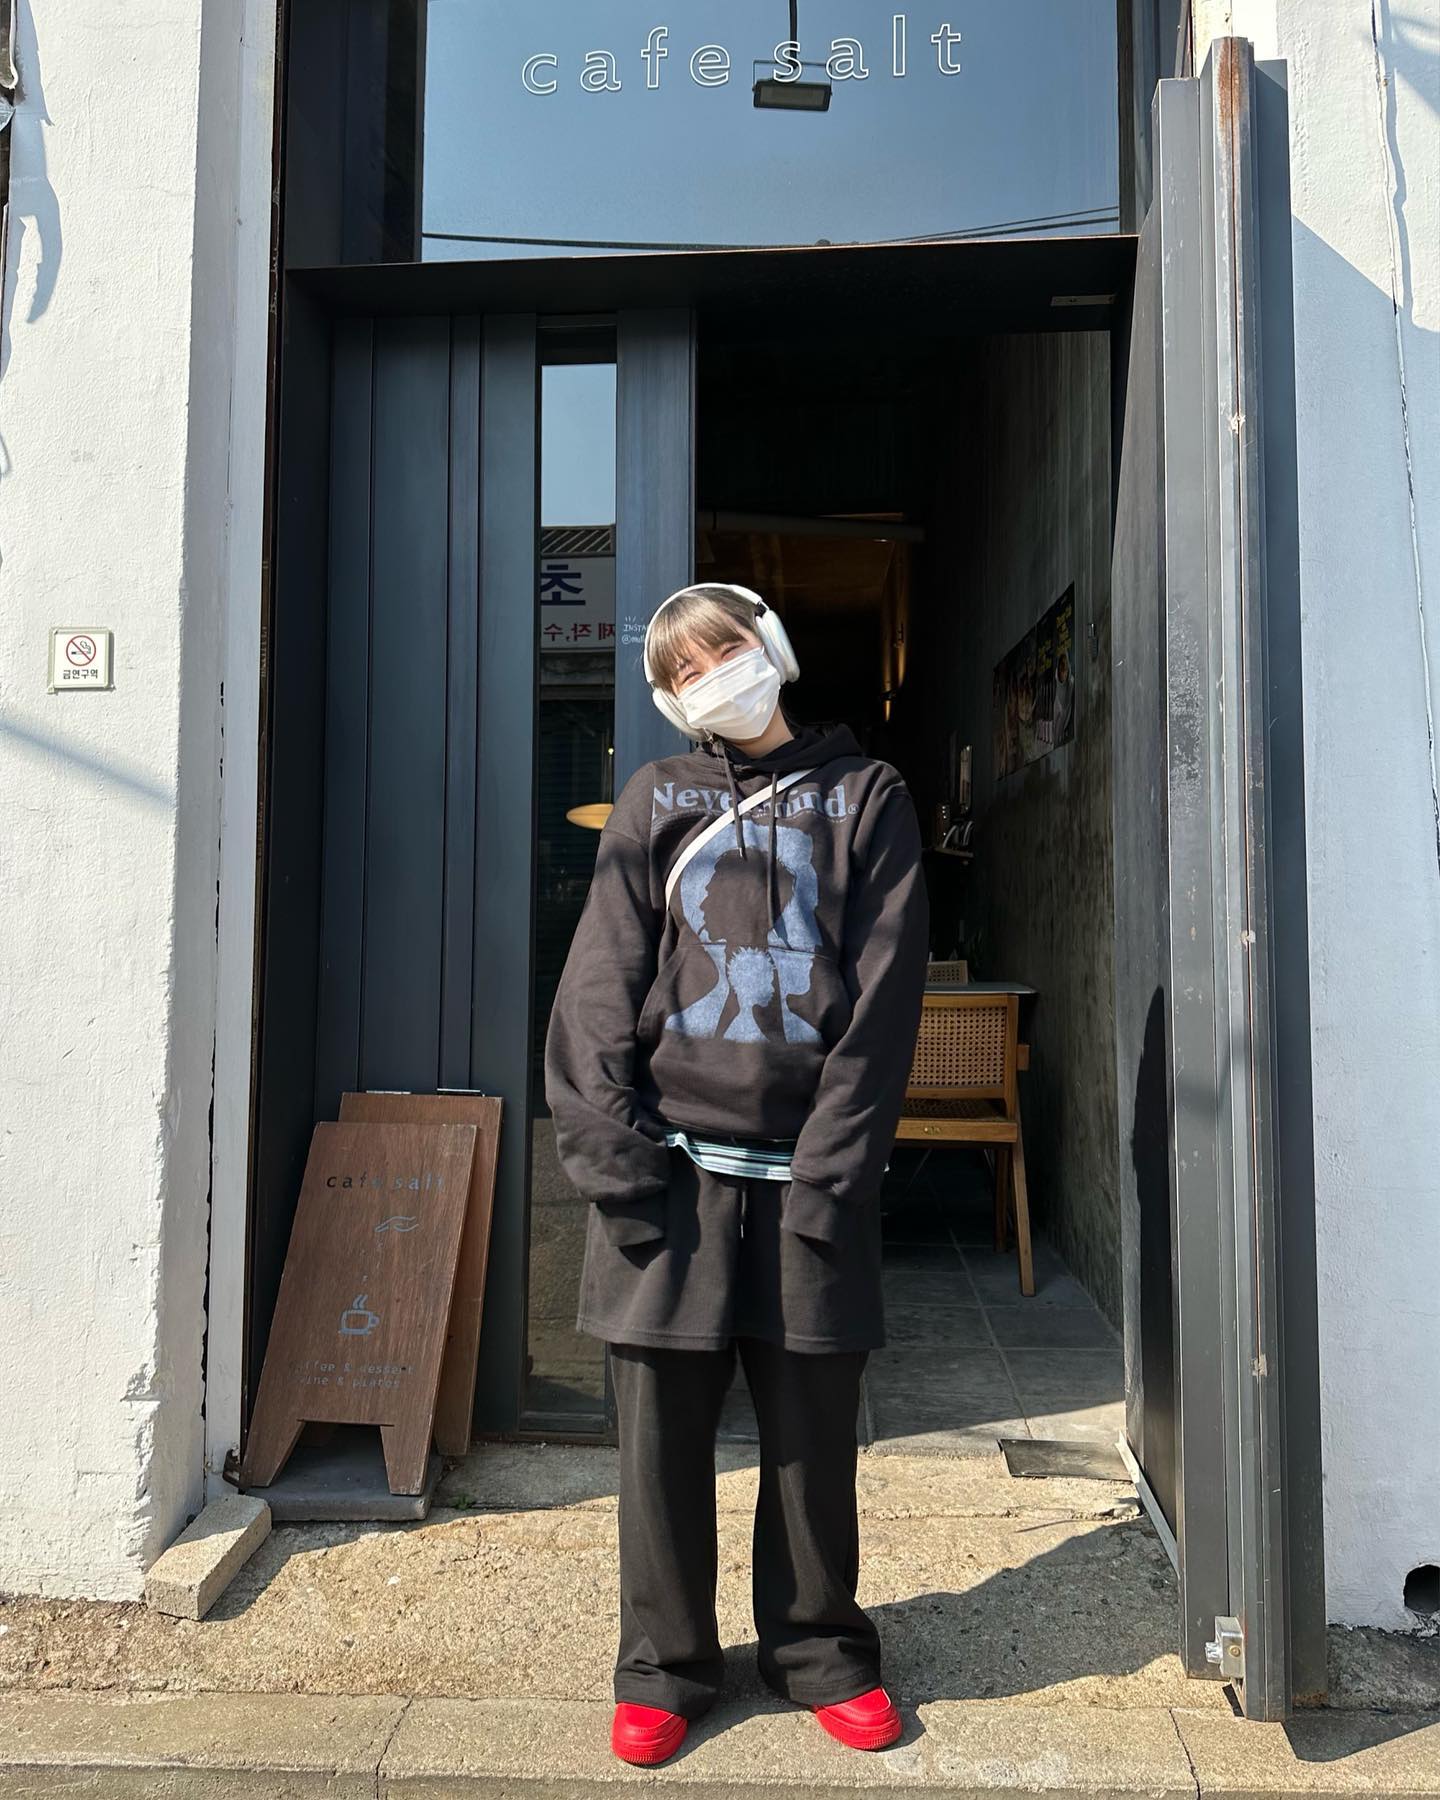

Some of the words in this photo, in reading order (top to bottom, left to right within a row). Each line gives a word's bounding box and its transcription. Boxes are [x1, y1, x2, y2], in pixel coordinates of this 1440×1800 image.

[521, 27, 730, 95] cafe
[773, 14, 961, 82] salt
[63, 669, 98, 680] 금연구역
